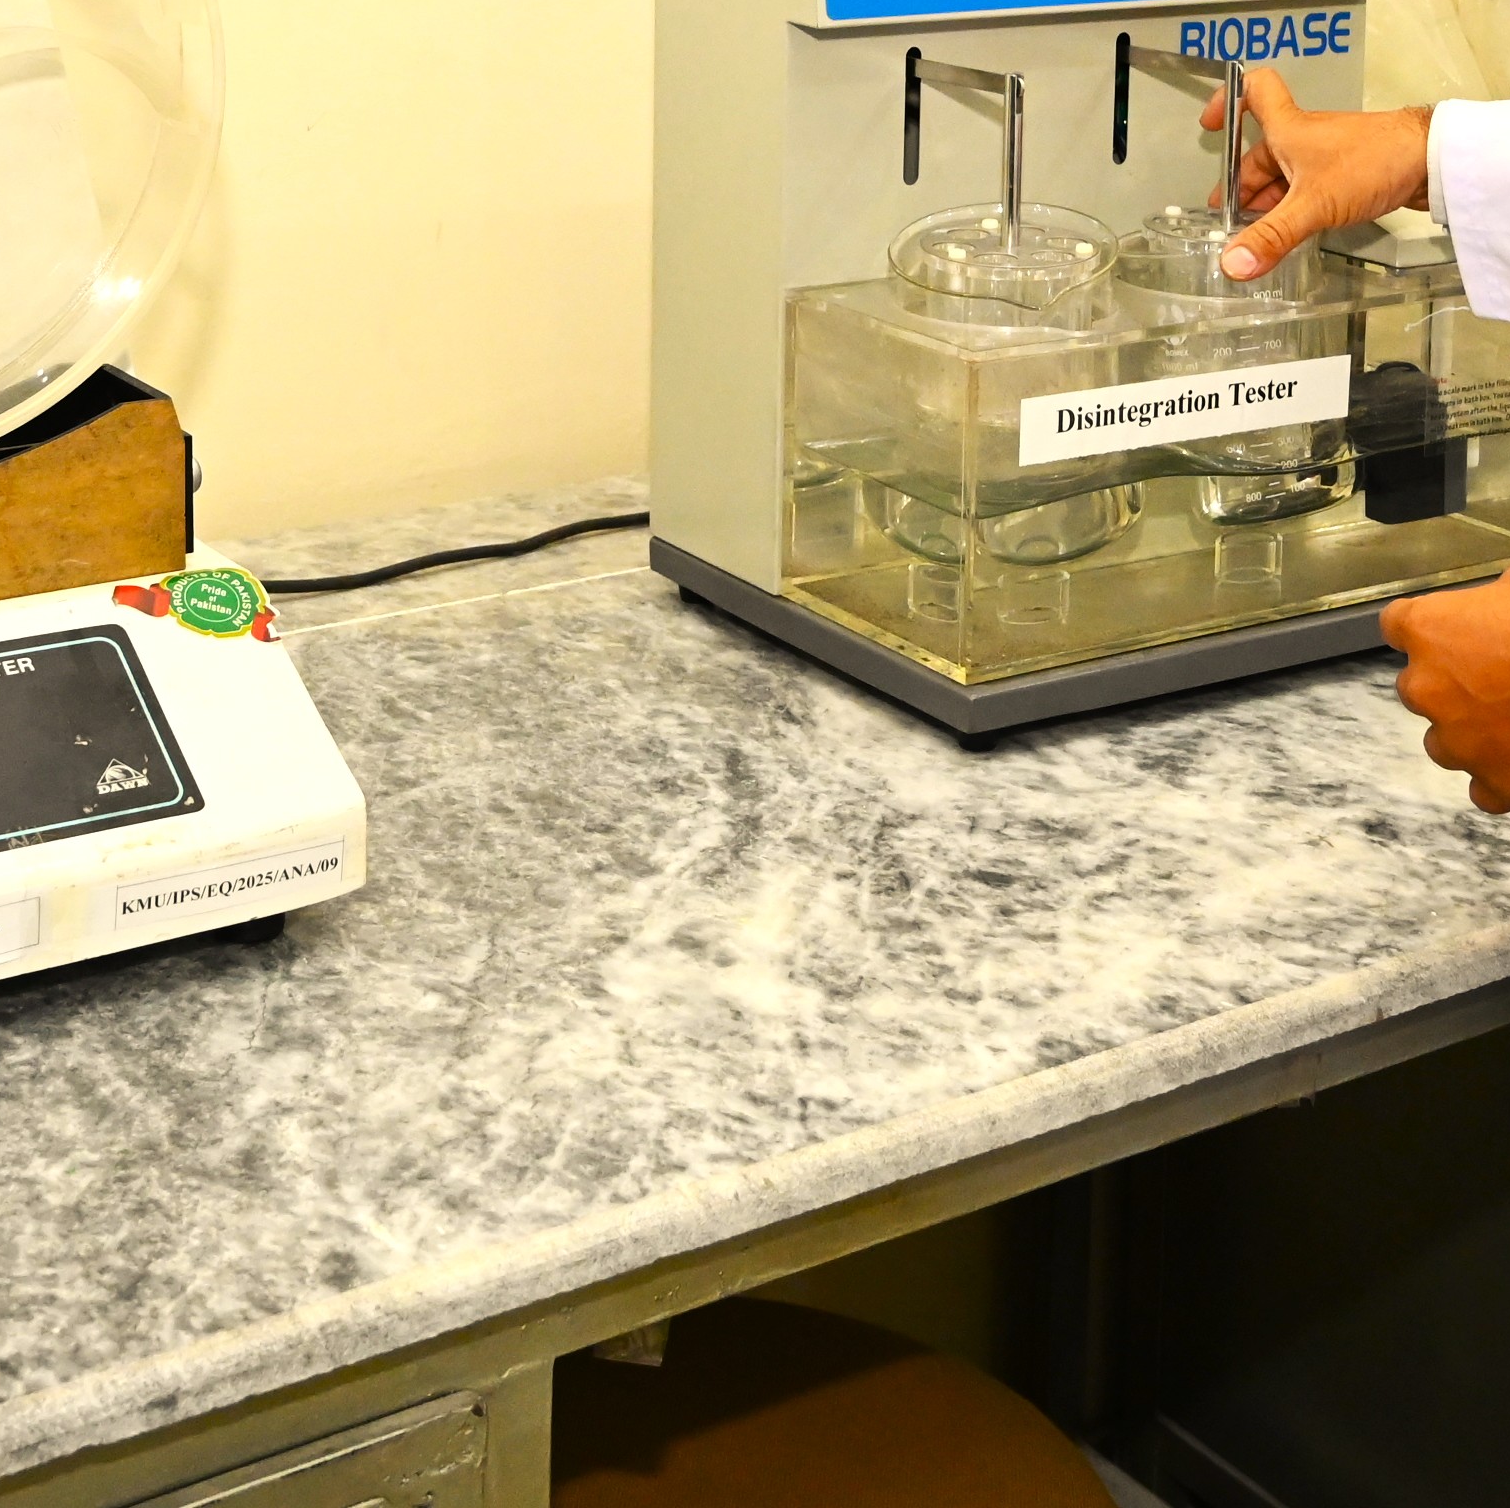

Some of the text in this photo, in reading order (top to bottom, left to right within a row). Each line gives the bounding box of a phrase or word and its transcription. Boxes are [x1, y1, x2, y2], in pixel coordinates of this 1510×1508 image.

[1181, 11, 1350, 62] BIOBASE
[1213, 348, 1232, 357] 200
[1264, 339, 1281, 350] 700
[1056, 379, 1298, 434] Disintegration Tester
[1246, 492, 1261, 502] 800
[172, 572, 251, 627] PRODUCTS OF PAKISTAN
[201, 584, 226, 597] Pride
[191, 598, 232, 615] Pakistan
[97, 776, 148, 796] DAWN
[121, 856, 339, 917] KMU/IPS/EQ/2025/ANA/09
